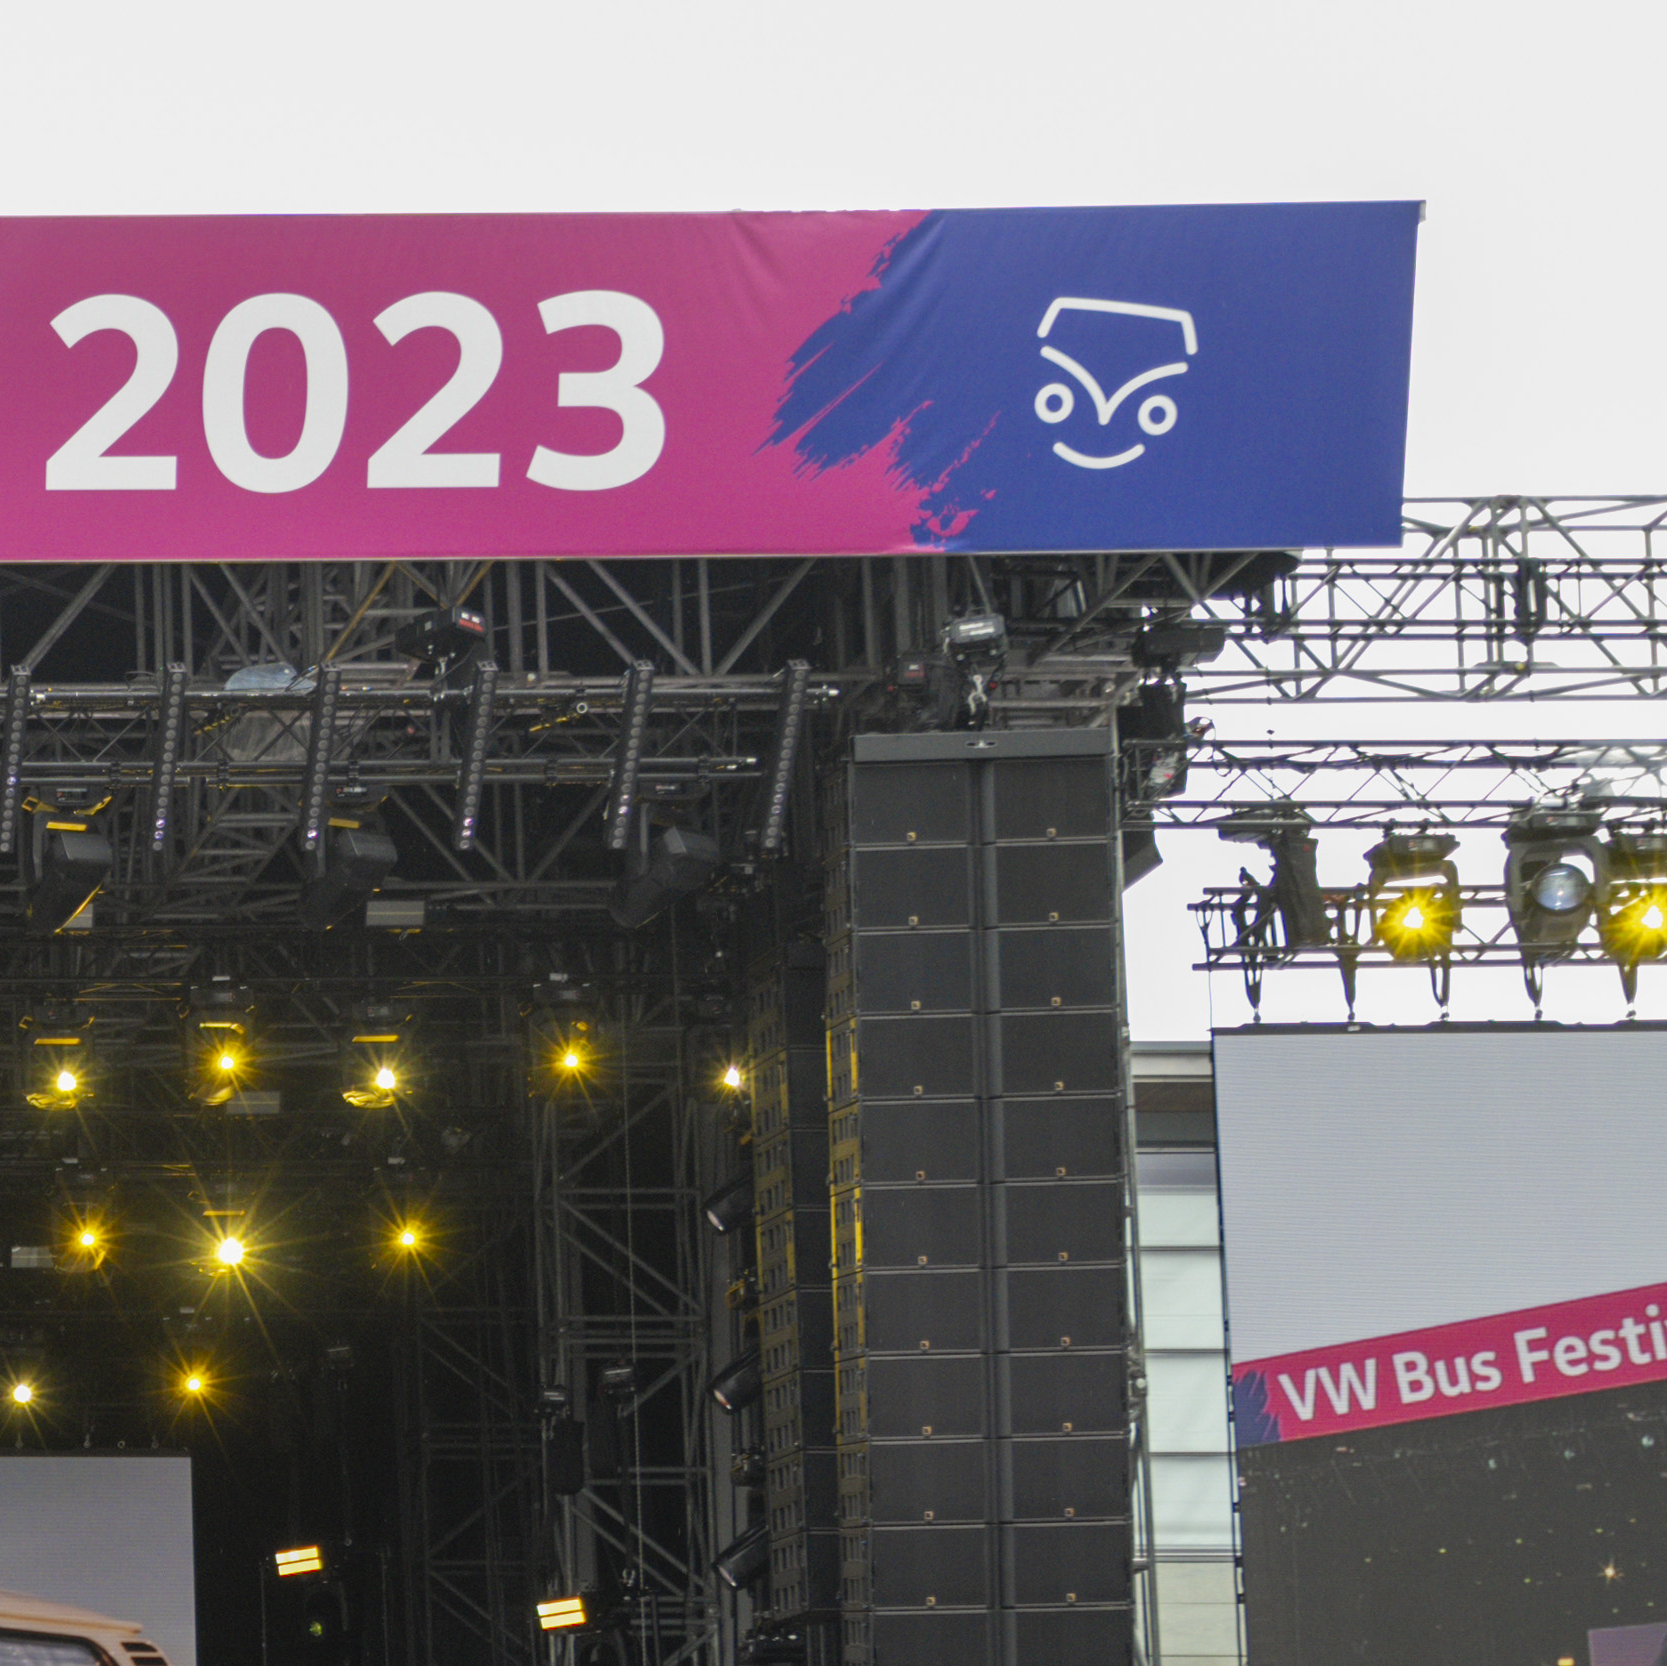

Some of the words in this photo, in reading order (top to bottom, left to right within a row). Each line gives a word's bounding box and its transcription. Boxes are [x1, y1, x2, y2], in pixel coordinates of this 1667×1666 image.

[45, 289, 667, 494] 2023
[1277, 1358, 1377, 1422] VW
[1393, 1351, 1502, 1404] Bus
[1514, 1304, 1667, 1384] Festi
